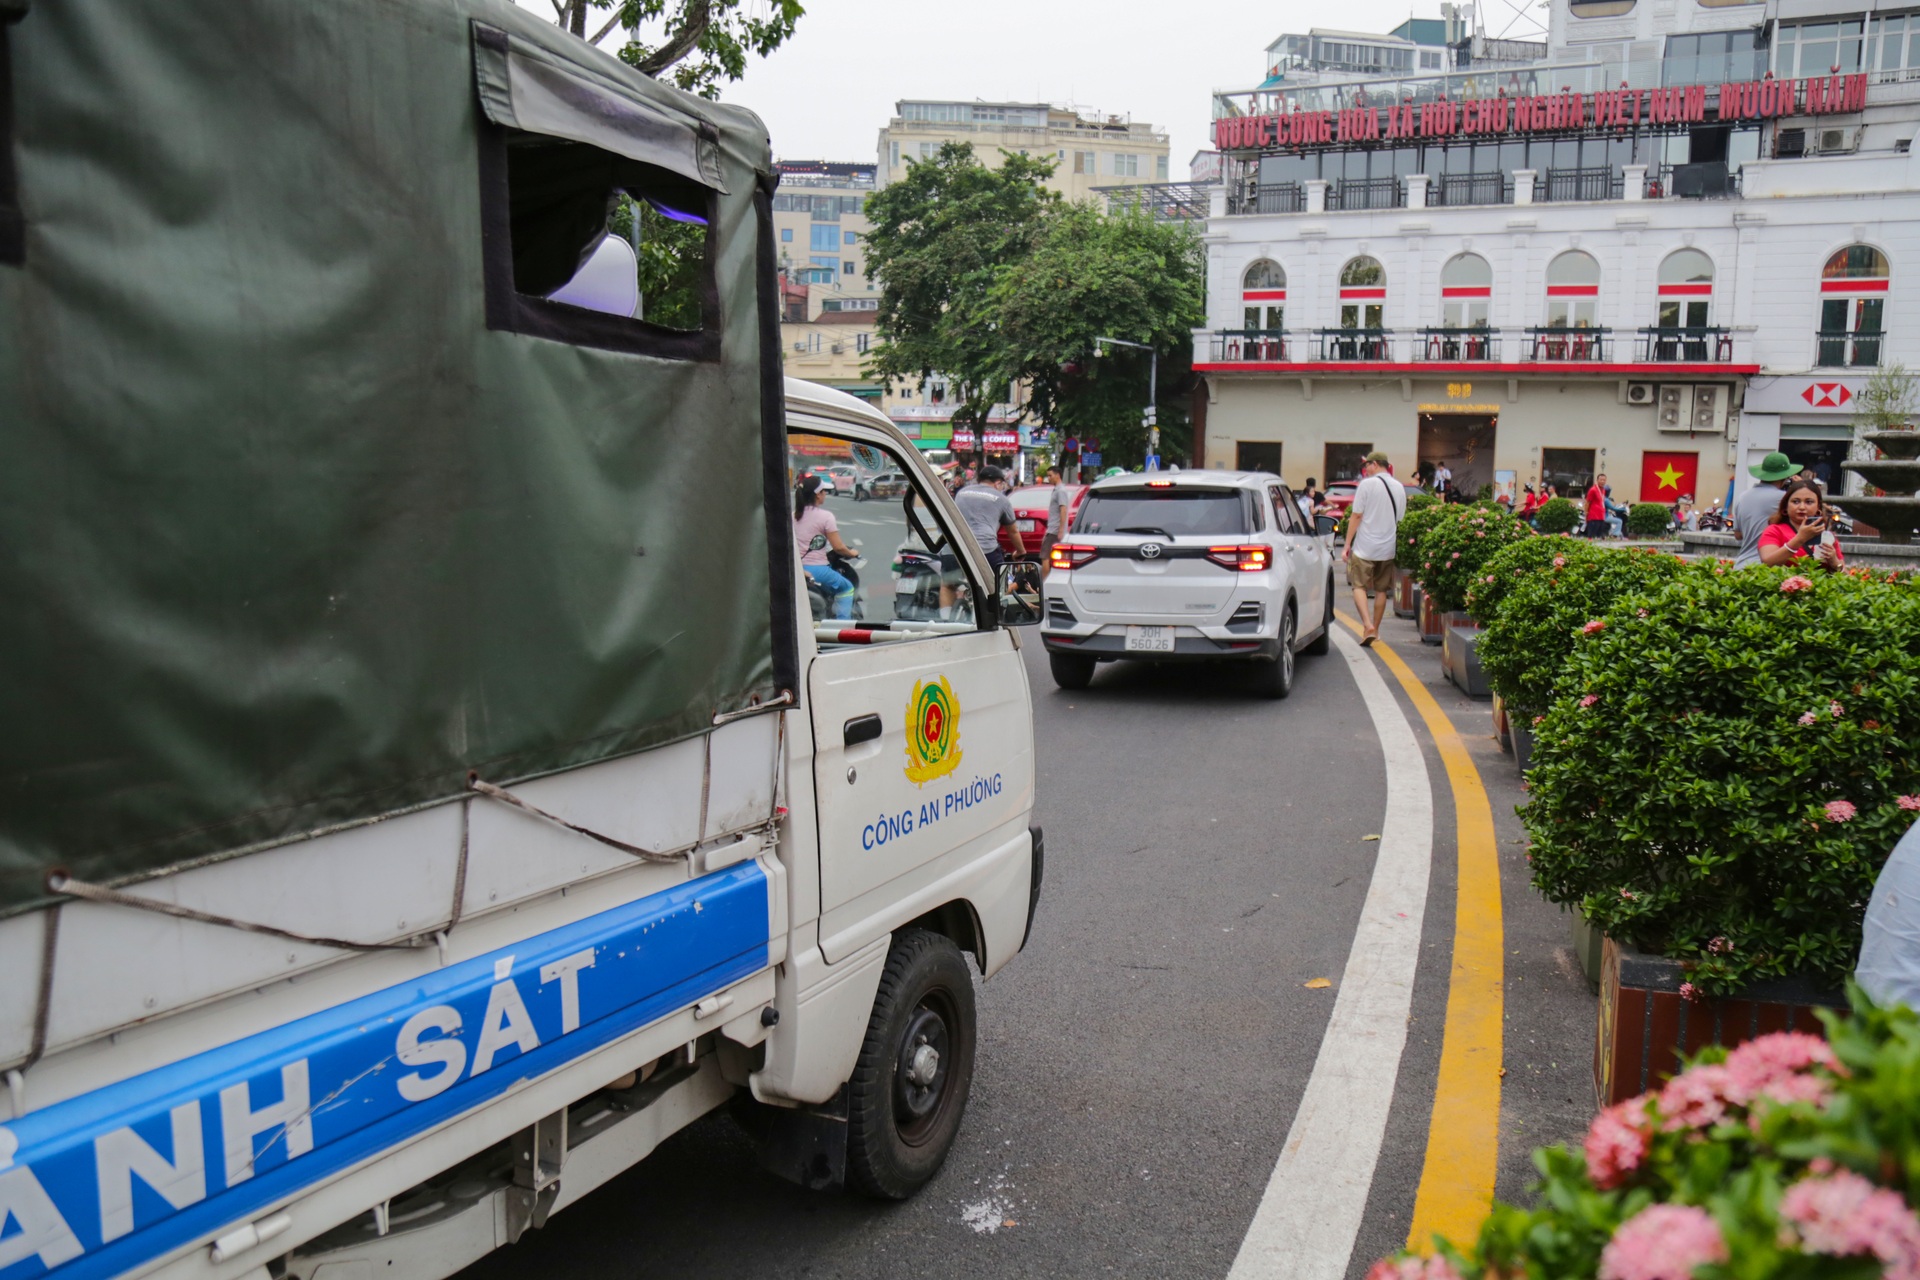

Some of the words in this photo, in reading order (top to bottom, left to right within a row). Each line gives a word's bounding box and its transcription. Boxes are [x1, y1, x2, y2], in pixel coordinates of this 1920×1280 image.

[1216, 106, 1271, 149] NƯỚC
[1277, 104, 1331, 152] CỘNG
[1338, 97, 1380, 141] HÒA
[1386, 96, 1415, 138] XÃ
[1420, 93, 1456, 144] HỘI
[1463, 87, 1508, 135] CHỦ
[1514, 85, 1584, 132] NGHĨA
[1594, 80, 1645, 133] VIỆT
[1649, 85, 1705, 123] NAM
[1718, 70, 1796, 120] MUÔN
[1805, 65, 1868, 116] NĂM
[954, 434, 969, 443] THE
[989, 434, 1016, 443] COFFEE
[1131, 639, 1169, 650] 560.26
[1141, 626, 1161, 638] 30H
[862, 810, 913, 851] CÔNG
[918, 799, 939, 829] AN
[945, 773, 1002, 817] PHƯỜNG
[395, 947, 596, 1102] SÁT
